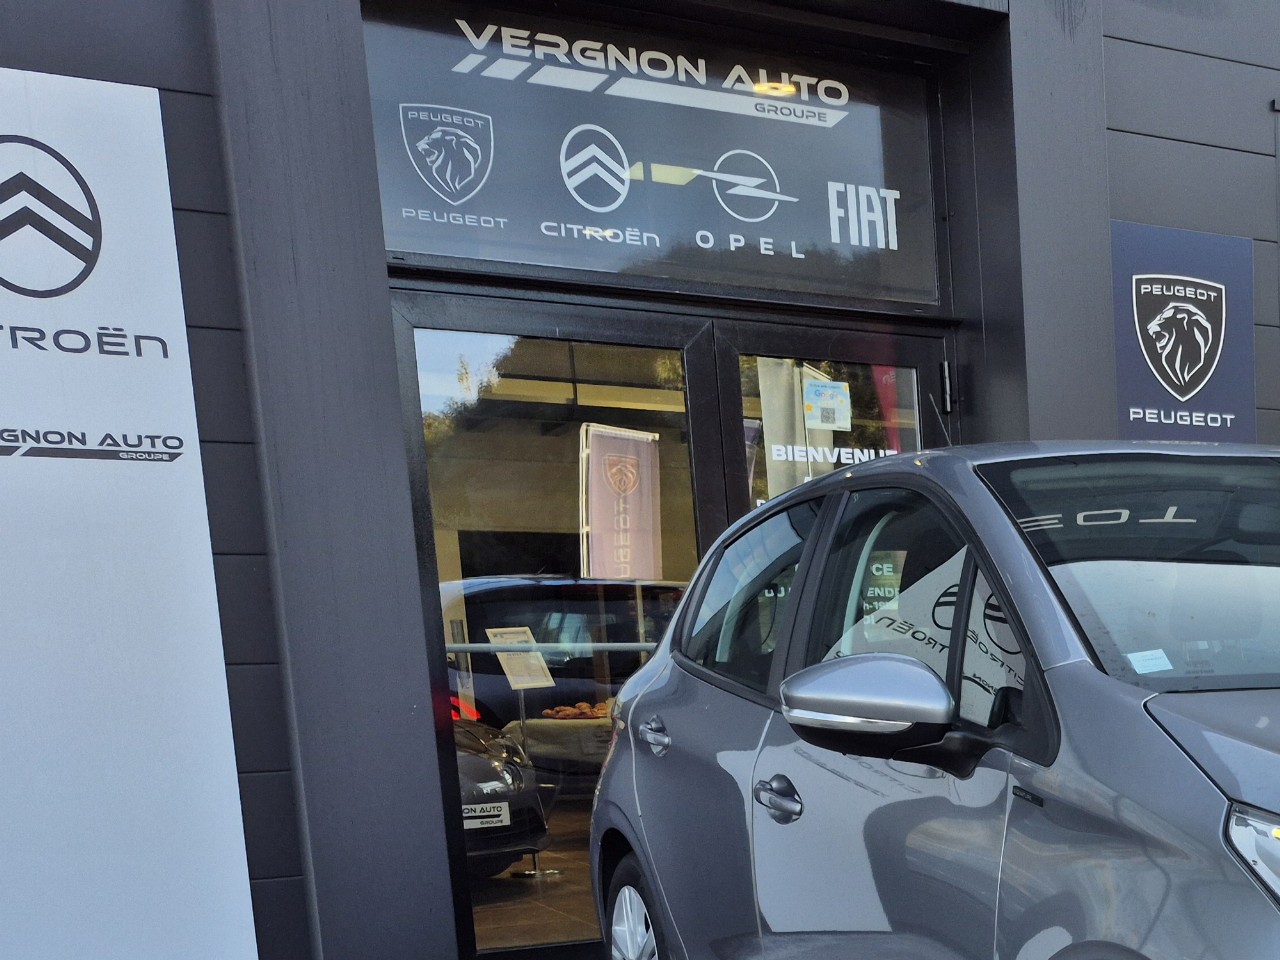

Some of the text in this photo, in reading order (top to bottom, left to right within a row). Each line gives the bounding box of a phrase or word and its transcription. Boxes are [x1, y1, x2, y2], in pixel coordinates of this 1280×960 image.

[455, 19, 849, 106] VERGNON AUTO
[408, 111, 485, 129] PEUGEOT
[755, 103, 828, 122] GROUPE
[402, 208, 508, 229] PEUGEOT
[828, 182, 900, 251] FIAT
[541, 222, 660, 248] CITROËN
[696, 230, 805, 259] OPEL
[1140, 284, 1218, 303] PEUGEOT
[0, 325, 169, 359] ROËN
[1129, 408, 1236, 428] PEUGEOT
[97, 432, 184, 450] AUTO
[119, 452, 171, 461] GROUPE
[479, 805, 503, 814] AUTO
